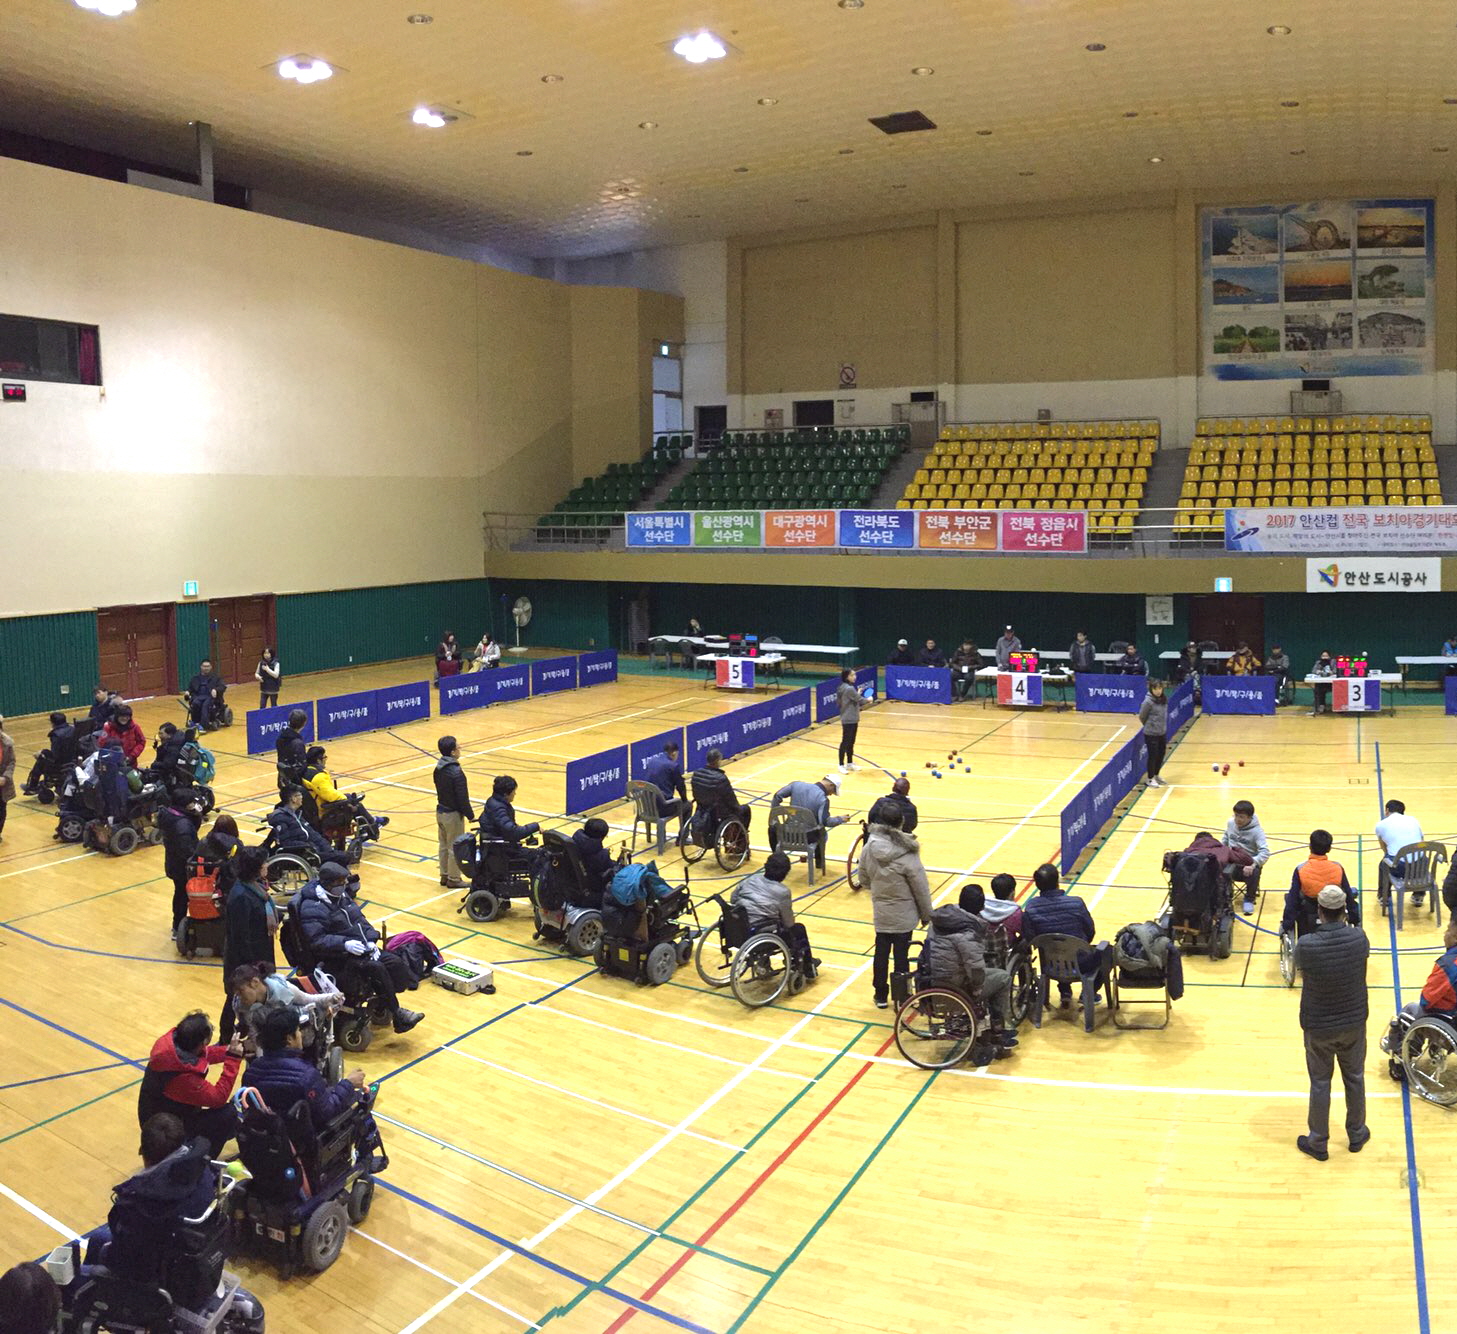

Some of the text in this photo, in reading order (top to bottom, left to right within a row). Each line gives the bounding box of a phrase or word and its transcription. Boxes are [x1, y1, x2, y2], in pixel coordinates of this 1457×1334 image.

[634, 515, 684, 529] 서울특별시
[701, 515, 755, 529] 울산광역시
[772, 515, 828, 529] 대구광역시
[853, 515, 900, 529] 전라북도
[925, 516, 992, 530] 전북 부안군
[1009, 517, 1079, 531] 전북 정읍시
[1266, 514, 1296, 528] 2017
[1300, 513, 1338, 528] 안산컵
[1342, 513, 1369, 529] 전국
[644, 530, 675, 543] 선수단
[712, 530, 744, 543] 선수단
[783, 530, 817, 543] 선수단
[858, 531, 894, 544] 선수단
[938, 532, 977, 545] 선수단
[1024, 533, 1064, 547] 선수단
[1344, 571, 1427, 586] 안산도시공사
[732, 665, 740, 679] 5
[1015, 680, 1025, 696] 4
[1352, 685, 1362, 701] 3
